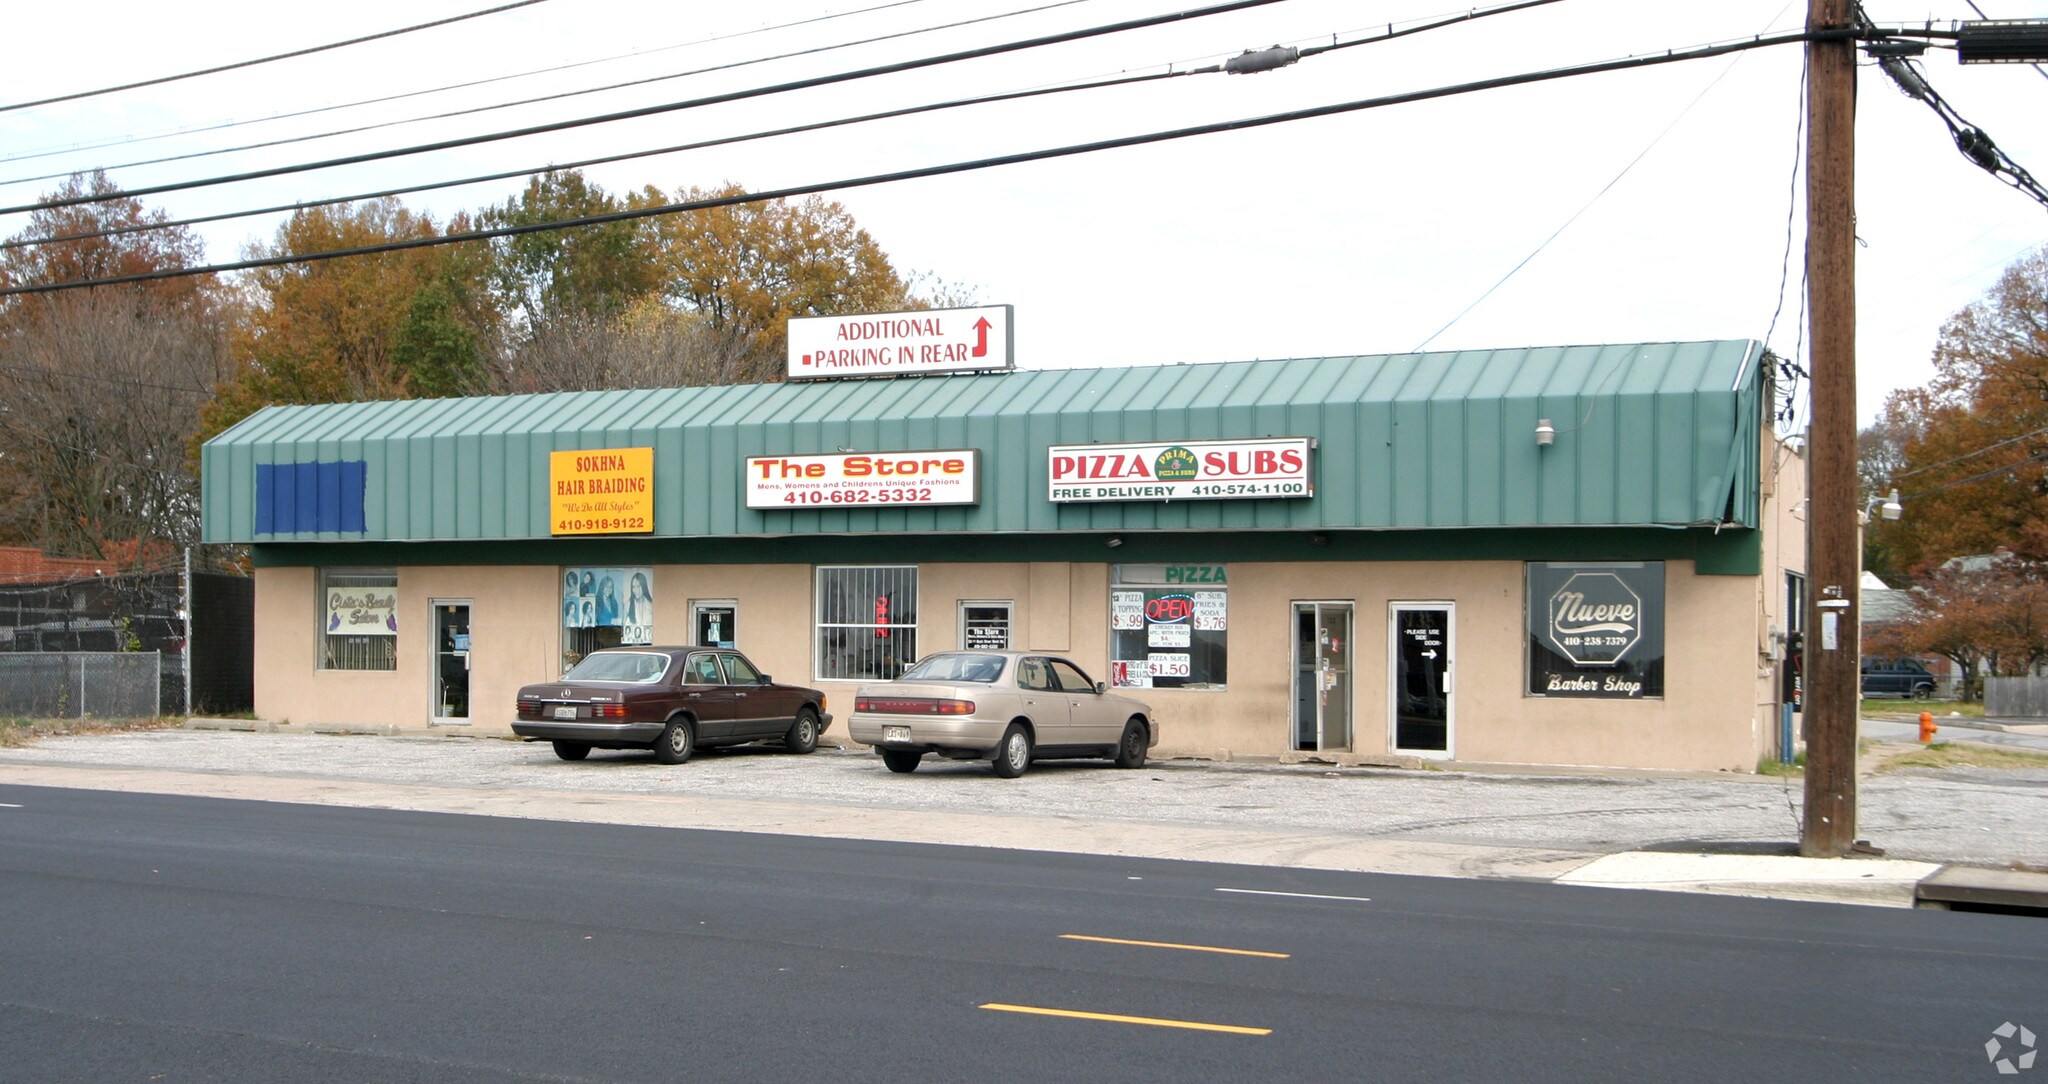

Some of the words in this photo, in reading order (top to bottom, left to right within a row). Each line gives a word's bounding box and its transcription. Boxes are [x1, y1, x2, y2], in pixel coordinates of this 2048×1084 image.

[837, 318, 944, 341] ADDITIONAL
[815, 347, 892, 368] PARKING
[899, 346, 915, 364] IN
[921, 343, 968, 363] REAR
[576, 455, 625, 473] SOKHNA
[1052, 454, 1151, 480] PIZZA
[1203, 449, 1303, 476] SUBS
[1158, 449, 1194, 465] PRIMA
[753, 459, 826, 480] The
[843, 456, 965, 478] Store
[557, 480, 585, 496] HAIR
[589, 477, 645, 494] BRAIDING
[841, 480, 884, 488] Childrens
[885, 480, 917, 488] Unique
[919, 478, 960, 486] Fashions
[1053, 487, 1092, 499] FREE
[1097, 486, 1176, 498] DELIVERY
[1192, 483, 1303, 496] 410-574-1100
[783, 488, 932, 504] 410-682-5332
[581, 502, 593, 512] Do
[594, 501, 608, 511] All
[559, 517, 644, 530] 410-918-9122
[1165, 566, 1227, 583] PIZZA
[1124, 594, 1143, 602] PIZZA
[1146, 599, 1193, 618] OPEN
[1555, 591, 1636, 623] Nueve
[1563, 637, 1628, 646] 410-238-7379
[1149, 662, 1189, 676] $1.50
[1547, 674, 1598, 691] Barber
[1603, 674, 1642, 696] Shop
